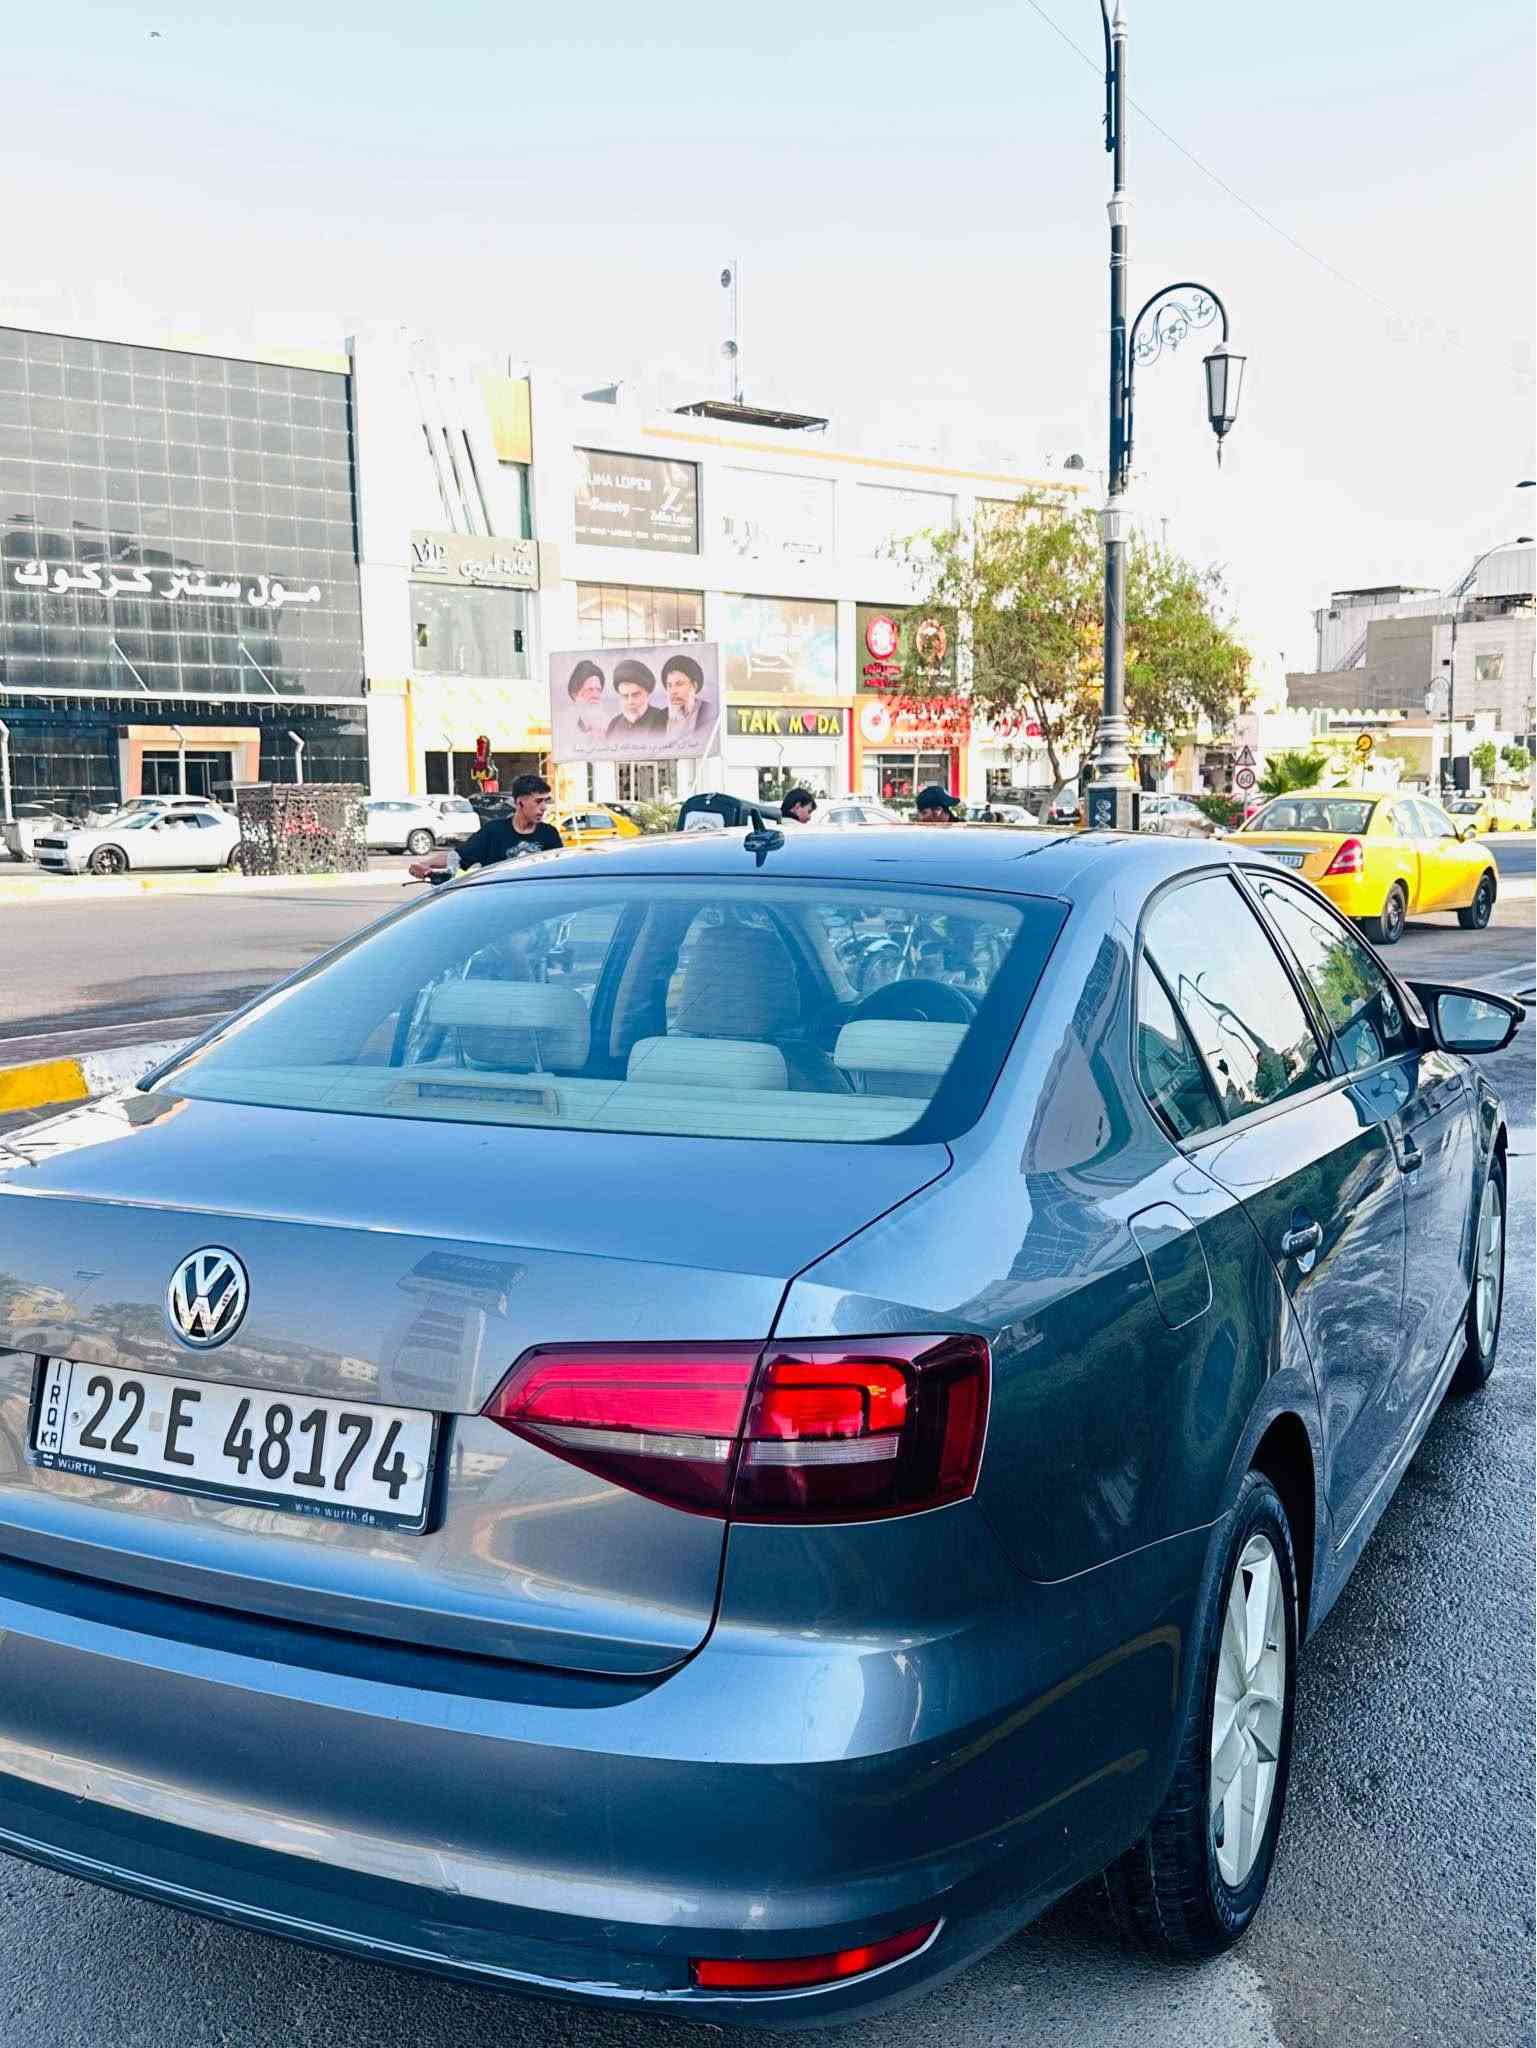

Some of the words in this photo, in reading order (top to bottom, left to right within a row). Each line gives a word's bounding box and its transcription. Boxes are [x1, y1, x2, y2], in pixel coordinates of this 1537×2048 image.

[14, 559, 152, 597] كركوك
[160, 567, 242, 600] سنتر
[248, 565, 321, 607] مول
[737, 708, 781, 734] TAK
[1240, 774, 1252, 785] 60
[40, 1431, 58, 1448] KR
[80, 1376, 145, 1455] 22
[164, 1387, 202, 1466] E
[223, 1398, 407, 1500] 48174
[294, 1502, 376, 1526] www.wurth.de
